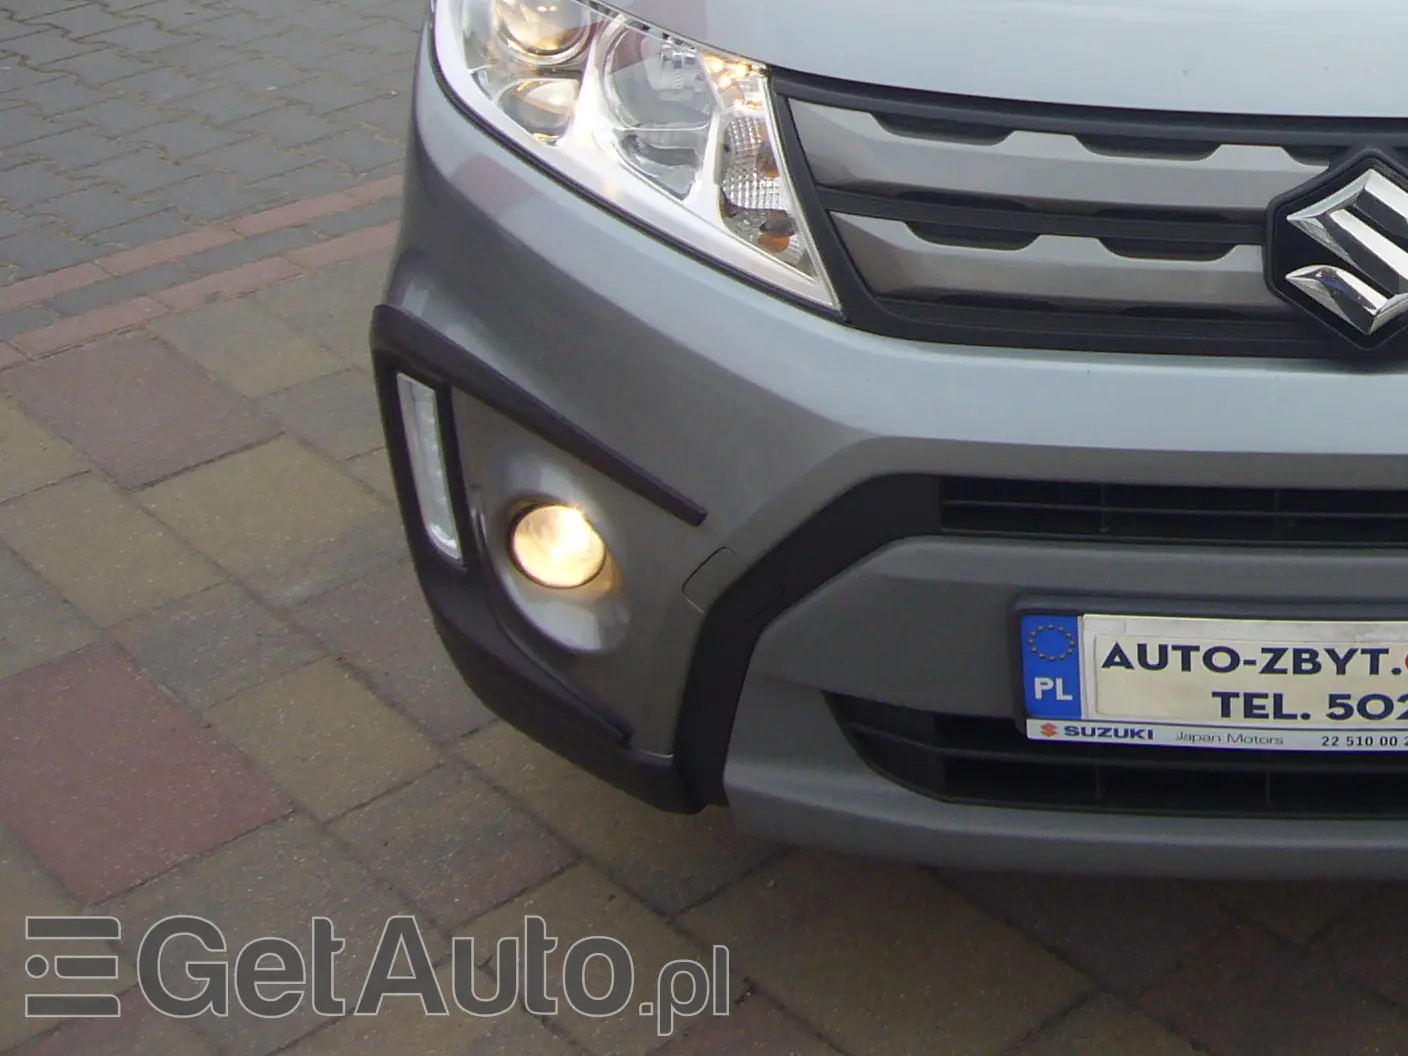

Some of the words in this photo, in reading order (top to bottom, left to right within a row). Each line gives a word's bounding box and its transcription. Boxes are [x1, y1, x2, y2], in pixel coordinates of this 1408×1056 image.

[1034, 677, 1073, 701] PL
[1211, 691, 1311, 720] TEL.
[1063, 725, 1154, 740] SUZUKI
[1175, 731, 1221, 743] Japan
[1227, 732, 1284, 745] Motors
[1321, 735, 1339, 746] 22
[1346, 735, 1374, 746] 510
[1379, 735, 1398, 746] 00
